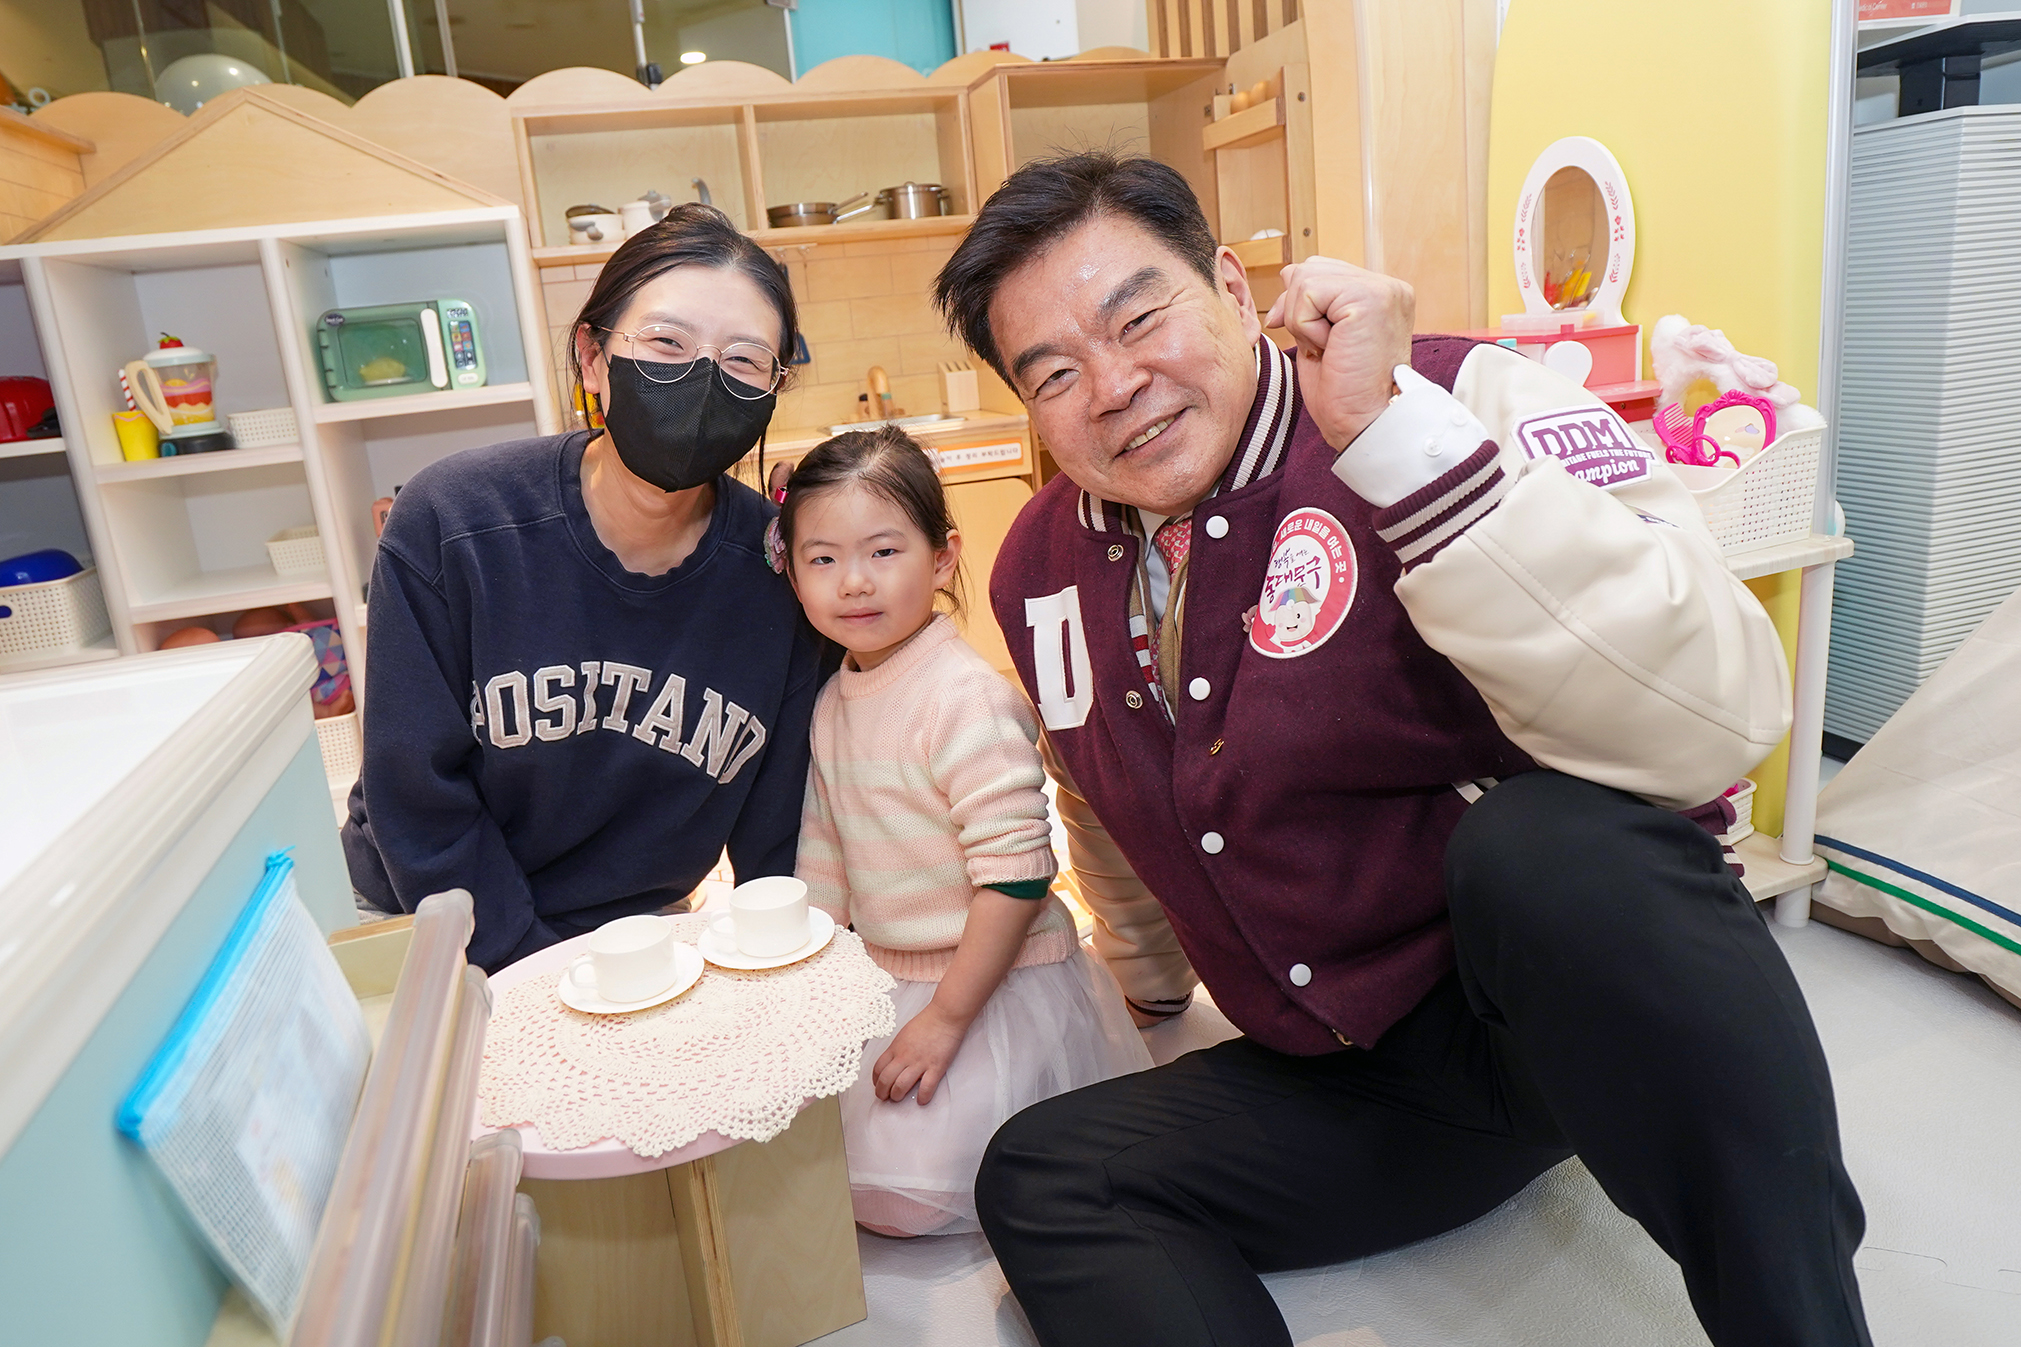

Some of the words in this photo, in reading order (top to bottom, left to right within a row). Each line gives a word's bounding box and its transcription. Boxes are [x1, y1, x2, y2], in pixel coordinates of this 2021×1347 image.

[1531, 418, 1627, 457] DDM
[1586, 449, 1610, 460] FUELS
[1608, 449, 1624, 457] THE
[1575, 458, 1640, 484] ampion
[1280, 519, 1303, 540] 새로운
[1304, 518, 1331, 540] 내일을
[1327, 536, 1343, 560] 여는
[1335, 560, 1347, 573] 곳
[1265, 555, 1322, 604] 동대문구
[1024, 584, 1094, 731] D
